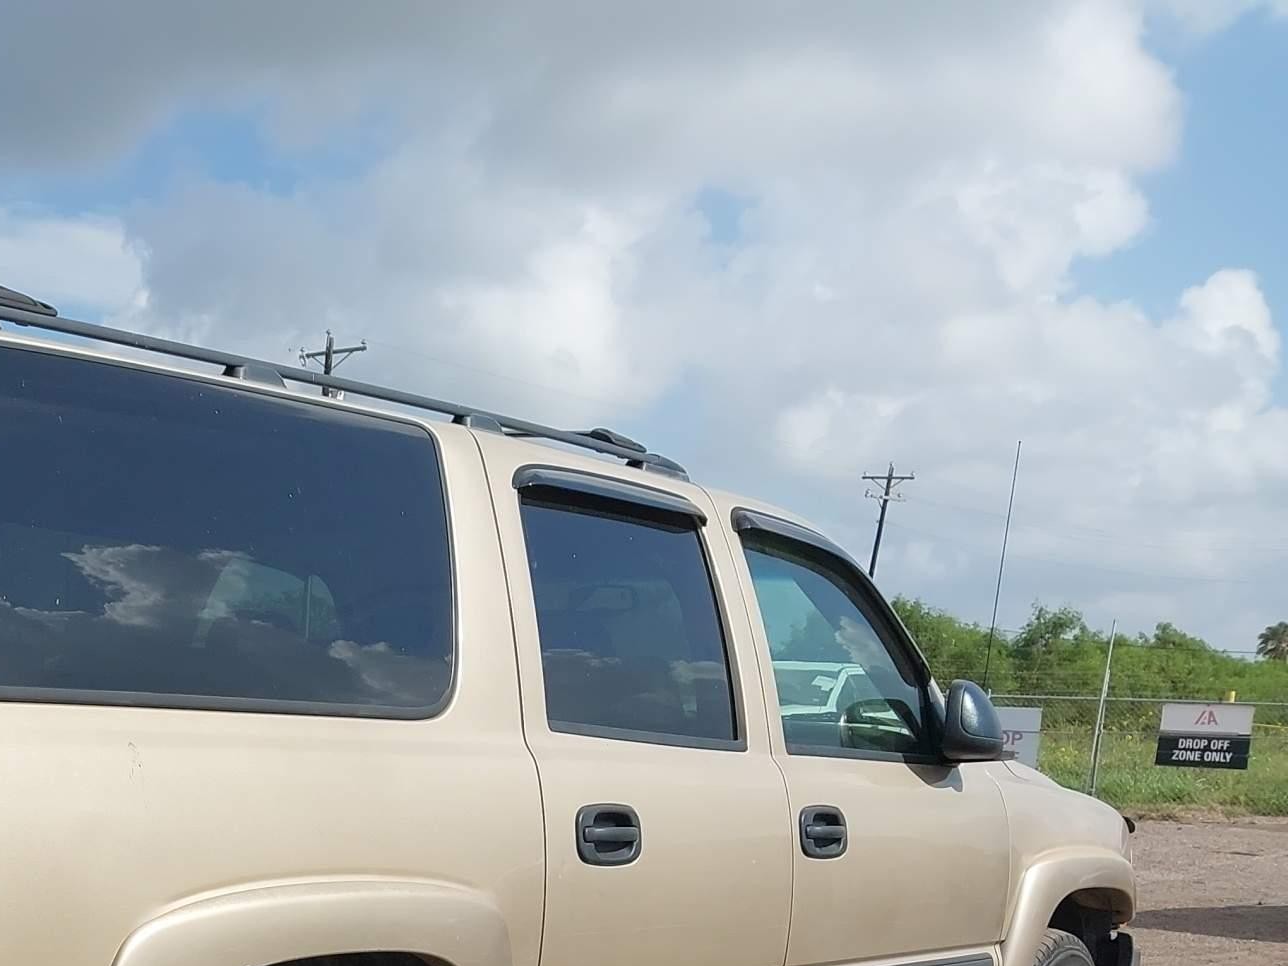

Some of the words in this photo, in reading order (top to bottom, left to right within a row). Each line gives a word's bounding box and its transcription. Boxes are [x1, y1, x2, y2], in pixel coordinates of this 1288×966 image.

[1178, 738, 1208, 749] DROP
[1210, 739, 1230, 750] OFF
[1172, 750, 1201, 761] ZONE
[1203, 751, 1233, 763] ONLY
